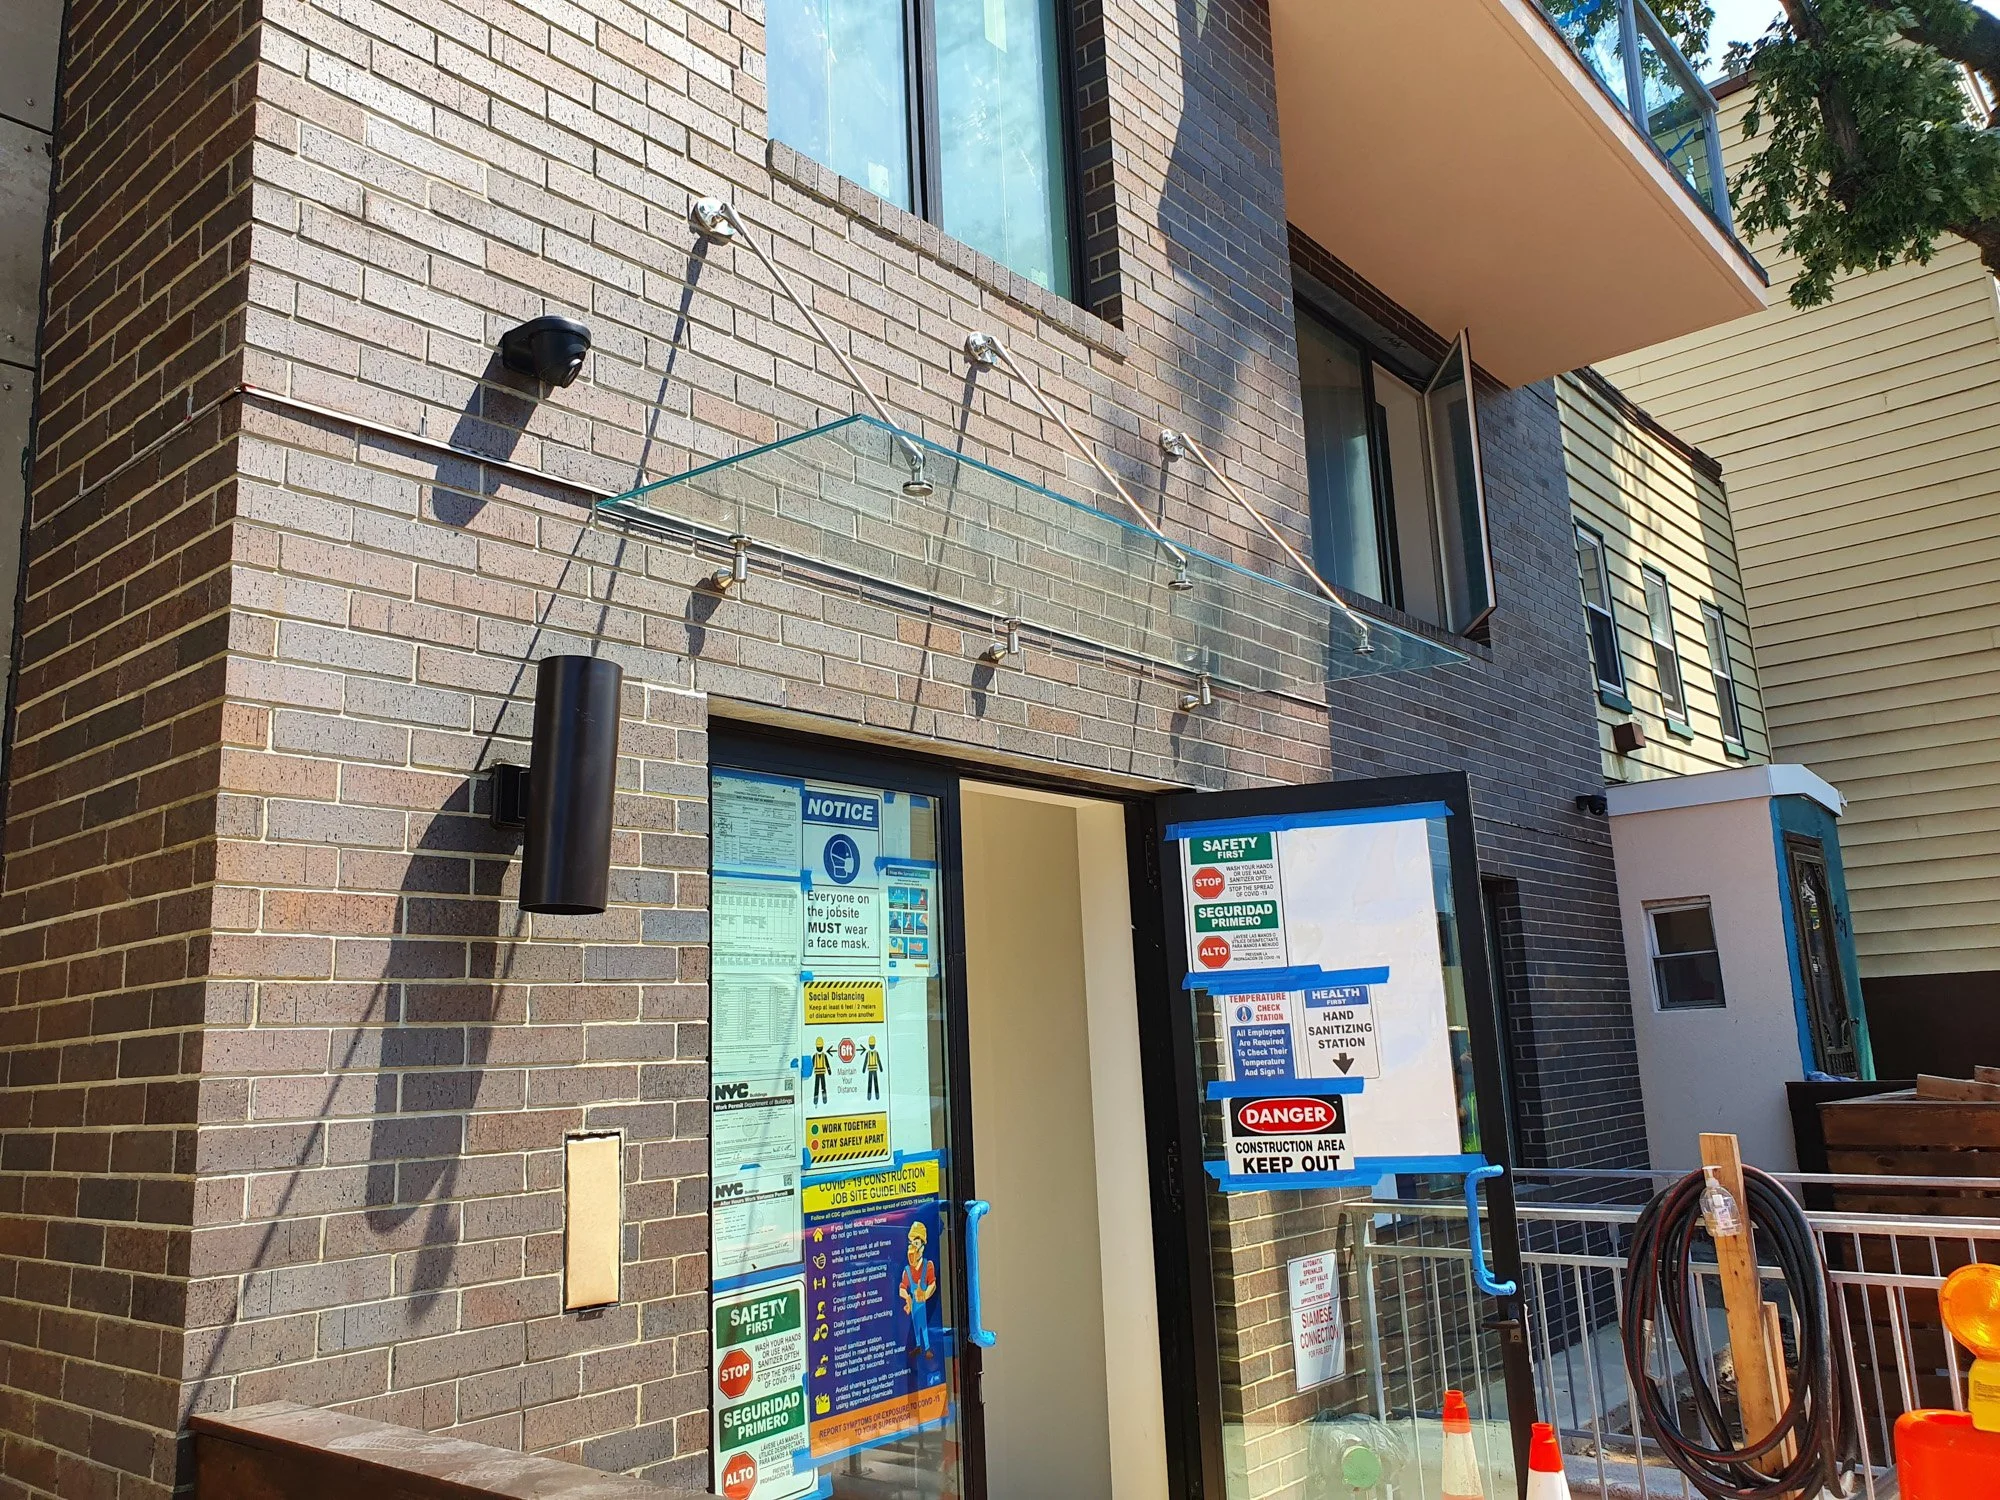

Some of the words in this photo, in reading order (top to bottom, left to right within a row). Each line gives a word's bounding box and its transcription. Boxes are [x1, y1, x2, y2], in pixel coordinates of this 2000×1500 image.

[808, 798, 873, 821] NOTICE
[1203, 837, 1257, 851] SAFETY
[1218, 850, 1244, 859] FIRST
[1196, 878, 1222, 887] STOP
[808, 890, 855, 904] Everyone
[858, 895, 869, 904] on
[808, 906, 823, 916] the
[826, 905, 859, 919] jobsite
[1199, 904, 1273, 918] SEGURIDAD
[808, 922, 841, 933] MUST
[845, 926, 868, 934] wear
[1212, 916, 1261, 927] PRIMERO
[808, 939, 814, 947] a
[817, 937, 838, 948] face
[841, 938, 869, 949] mask.
[1201, 947, 1227, 956] ALTO
[809, 992, 829, 1000] Social
[832, 992, 864, 1002] Distancing
[1229, 993, 1286, 1003] TEMPERATURE
[1312, 988, 1360, 999] HEALTH
[1257, 1004, 1280, 1012] CHECK
[1256, 1013, 1284, 1022] STATION
[1323, 1011, 1353, 1022] HAND
[1248, 1028, 1285, 1037] Employees
[1308, 1023, 1372, 1036] SANITIZING
[1239, 1039, 1251, 1047] Are
[1253, 1038, 1284, 1047] Required
[1318, 1037, 1365, 1049] STATION
[841, 1045, 852, 1056] 6ft
[1238, 1049, 1246, 1057] To
[1247, 1048, 1268, 1056] Check
[1242, 1058, 1285, 1067] Temperature
[1244, 1068, 1258, 1076] And
[1260, 1068, 1275, 1077] Sign
[1277, 1067, 1284, 1075] In
[715, 1083, 748, 1100] NYC
[1246, 1107, 1328, 1124] DANGER
[822, 1124, 841, 1133] WORK
[844, 1120, 876, 1131] TOGETHER
[822, 1139, 838, 1149] STAY
[840, 1136, 862, 1147] SAFELY
[864, 1134, 884, 1144] APART
[1236, 1141, 1312, 1153] CONSTRUCTION
[1317, 1140, 1345, 1151] AREA
[1243, 1156, 1293, 1173] KEEP
[1302, 1155, 1340, 1171] OUT
[819, 1180, 845, 1192] COVID
[853, 1176, 861, 1188] 19
[864, 1167, 925, 1185] CONSTRUCTION
[716, 1182, 743, 1198] NYC
[831, 1193, 847, 1205] JOB
[850, 1189, 868, 1202] SITE
[870, 1182, 916, 1199] GUIDELINES
[1302, 1258, 1322, 1268] AUTOMATIC
[1304, 1266, 1323, 1277] SPRINKLER
[1300, 1278, 1309, 1286] SHUT
[1318, 1273, 1328, 1282] VALVE
[1316, 1283, 1325, 1291] FEET
[1301, 1296, 1315, 1305] OPPOSITE
[731, 1297, 787, 1326] SAFETY
[1301, 1306, 1333, 1328] SIAMESE
[746, 1319, 773, 1335] FIRST
[755, 1342, 769, 1352] WASH
[770, 1339, 783, 1348] YOUR
[785, 1333, 801, 1344] HANDS
[1300, 1324, 1338, 1349] CONNECTION
[762, 1350, 770, 1358] OR
[771, 1348, 781, 1357] USE
[782, 1343, 795, 1354] HAND
[758, 1355, 783, 1368] SANITIZER
[722, 1363, 750, 1382] STOP
[757, 1372, 770, 1382] STOP
[772, 1369, 781, 1378] THE
[782, 1363, 801, 1376] SPREAD
[765, 1380, 772, 1388] OF
[773, 1376, 787, 1386] COVID
[724, 1392, 800, 1428] SEGURIDAD
[738, 1412, 788, 1440] PRIMERO
[820, 1424, 841, 1438] REPORT
[843, 1416, 872, 1431] SYMPTOMS
[874, 1412, 880, 1420] OR
[882, 1403, 910, 1419] EXPOSURE
[910, 1402, 917, 1410] TO
[855, 1428, 862, 1436] TO
[863, 1424, 877, 1434] YOUR
[879, 1413, 911, 1430] SUPERVISOR
[726, 1467, 754, 1487] ALTO
